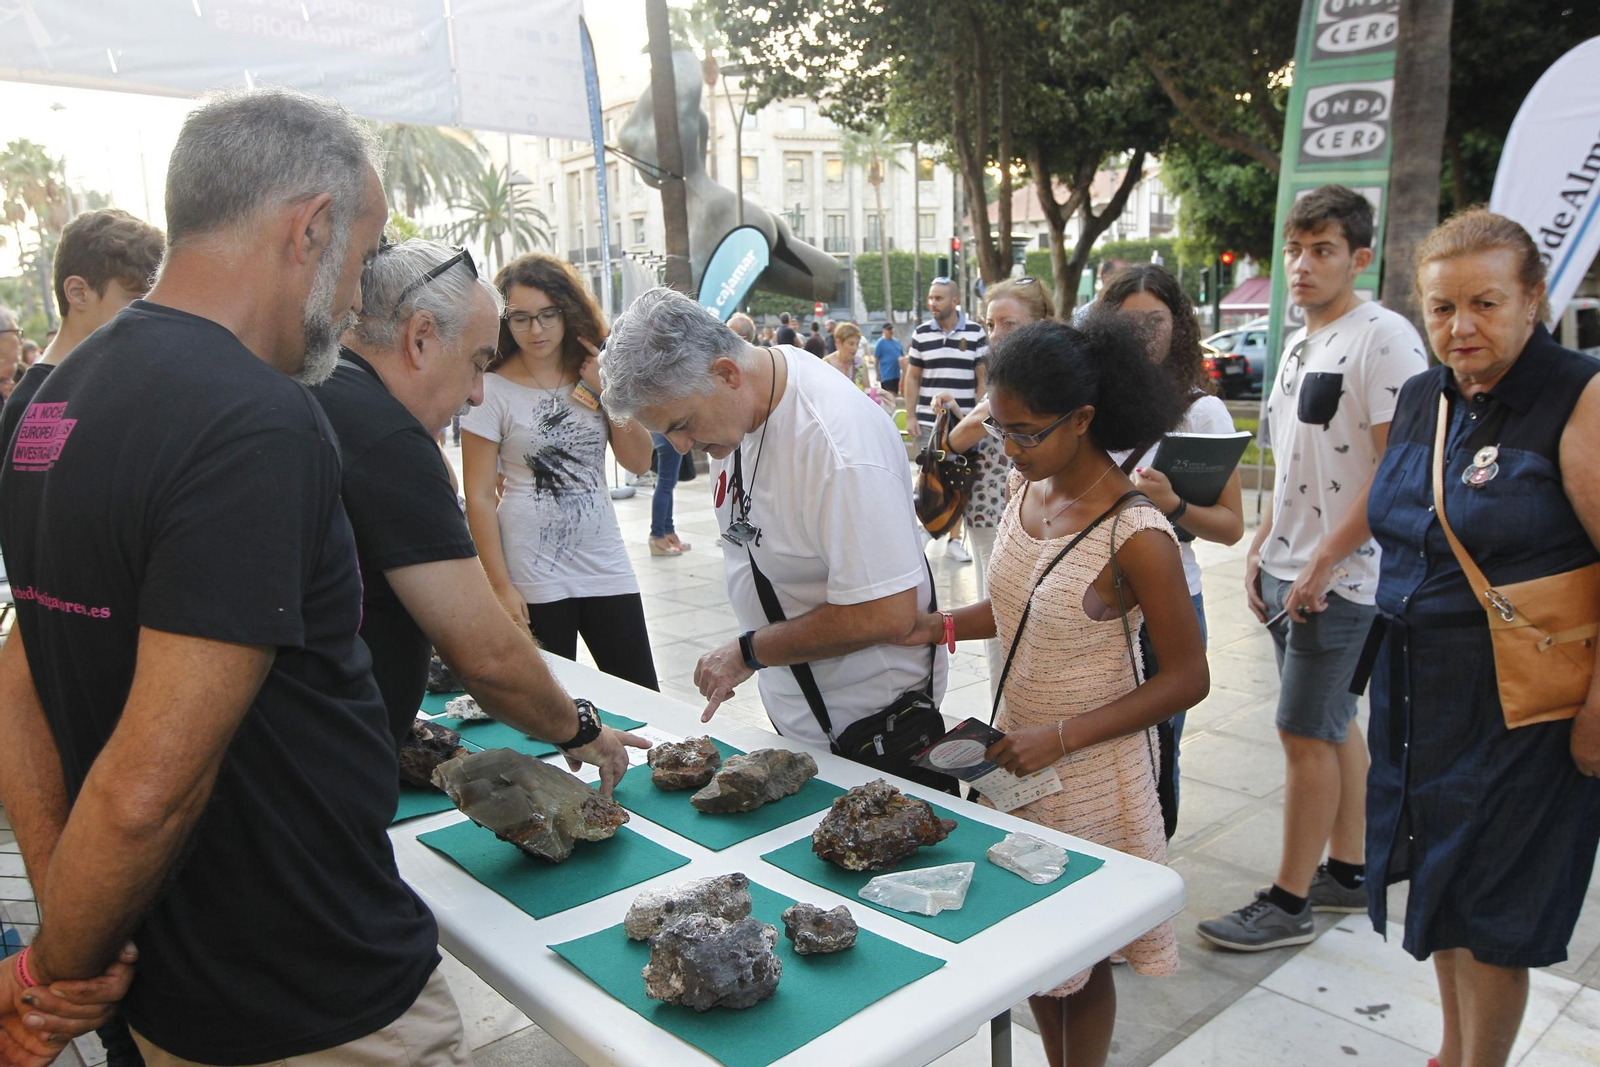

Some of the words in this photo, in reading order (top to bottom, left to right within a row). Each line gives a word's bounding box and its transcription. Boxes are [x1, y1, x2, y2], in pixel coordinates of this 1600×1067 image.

[1331, 21, 1395, 45] CERO
[1315, 98, 1383, 119] ONDA
[1316, 131, 1378, 150] CERO
[1540, 211, 1576, 249] de
[1560, 131, 1600, 211] Alm
[716, 250, 755, 306] cajamar
[27, 406, 38, 419] LA
[39, 405, 66, 419] NOCHE
